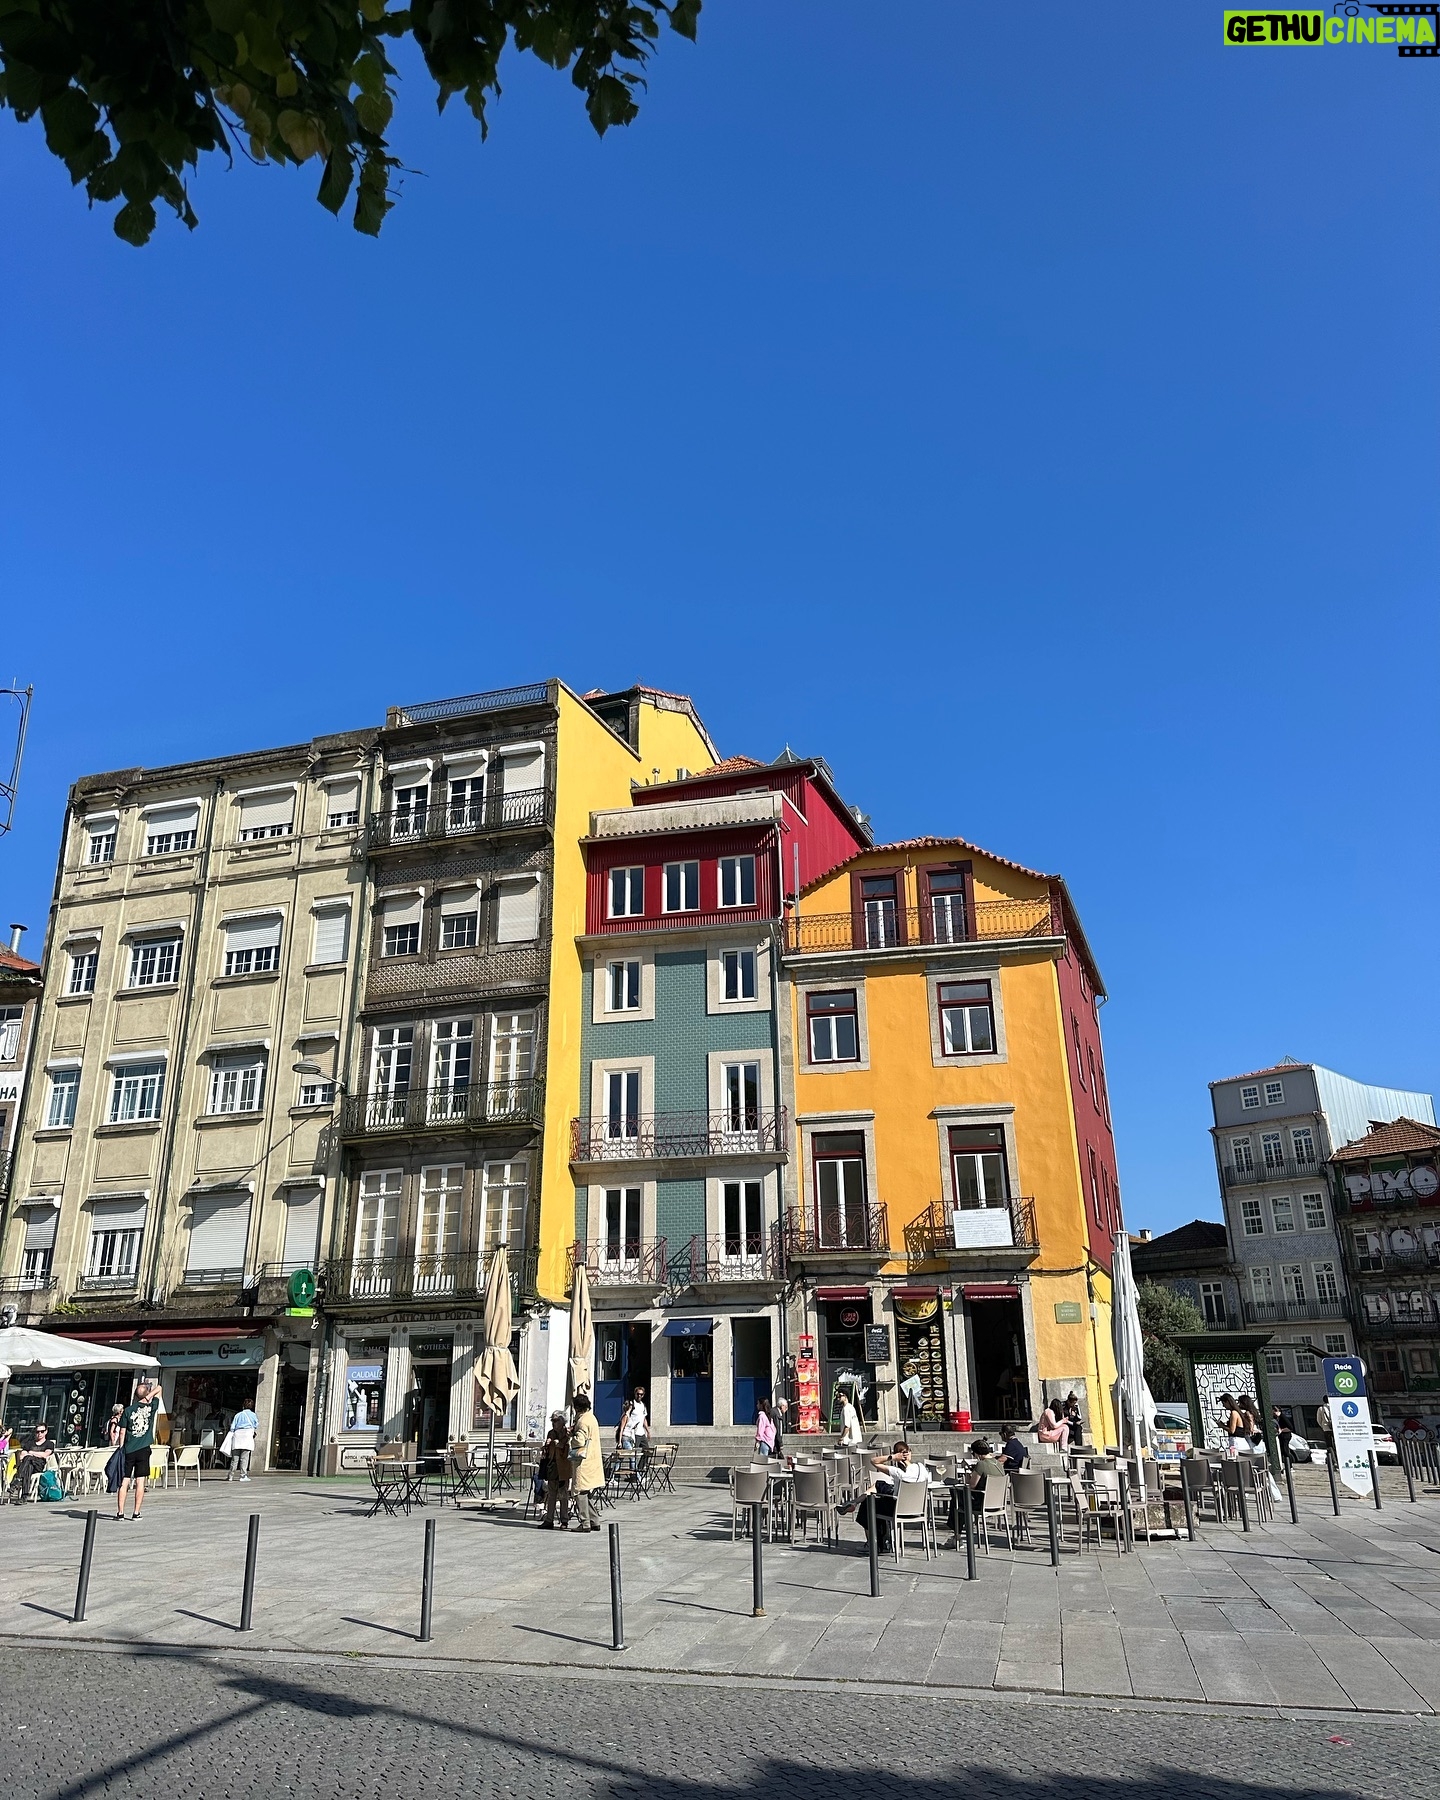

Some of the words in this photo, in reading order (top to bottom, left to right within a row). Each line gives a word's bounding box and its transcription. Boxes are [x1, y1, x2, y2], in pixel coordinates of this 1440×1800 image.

[1342, 1165, 1439, 1205] PIXO
[392, 1312, 426, 1323] ANTIGA
[429, 1311, 441, 1321] DA
[444, 1310, 474, 1320] PORTA
[416, 1343, 452, 1351] APOTHEKE
[1338, 1377, 1353, 1388] 20
